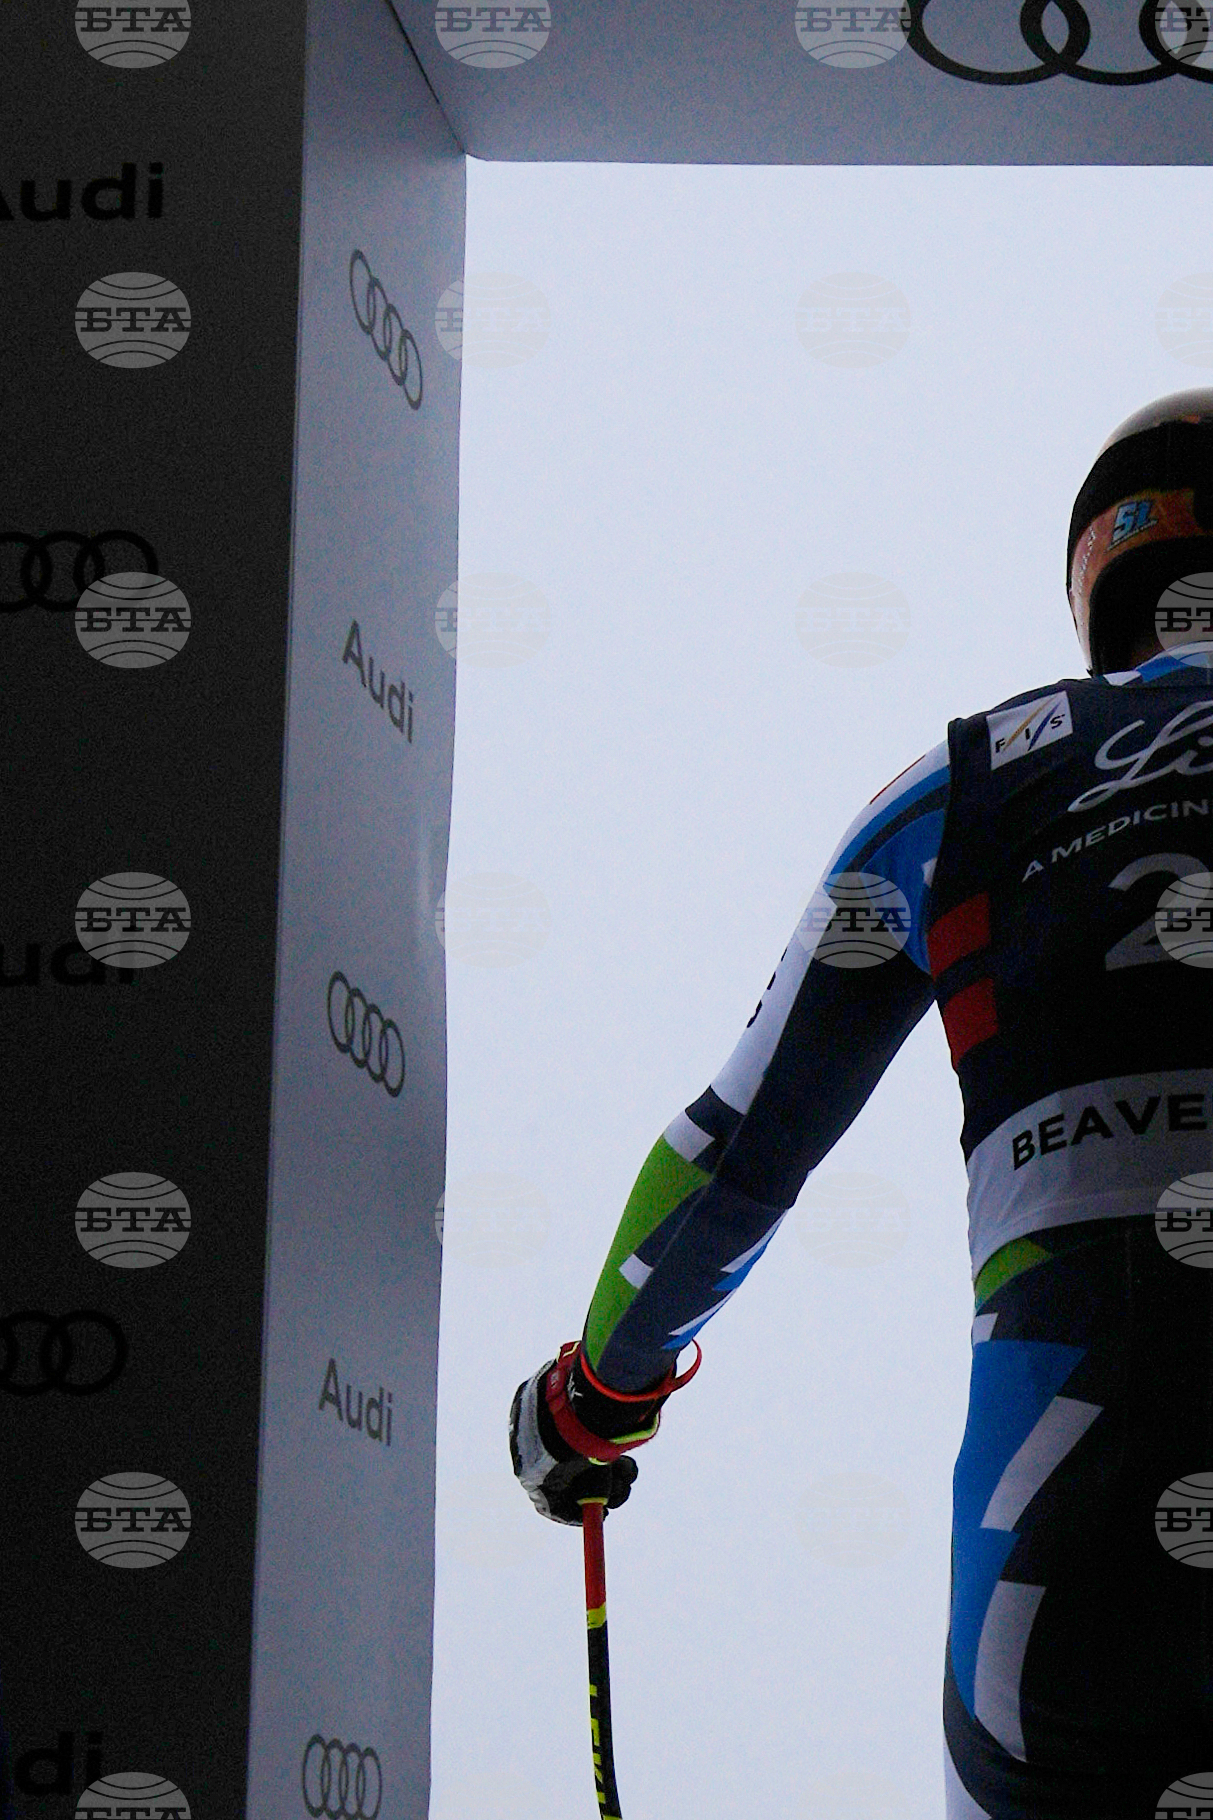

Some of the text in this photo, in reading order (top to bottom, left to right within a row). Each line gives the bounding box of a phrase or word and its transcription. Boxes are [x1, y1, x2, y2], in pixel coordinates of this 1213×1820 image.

[0, 162, 164, 222] udi
[342, 620, 413, 744] Audi
[995, 713, 1065, 753] FIS
[1021, 860, 1044, 883] A
[319, 1358, 392, 1447] Audi
